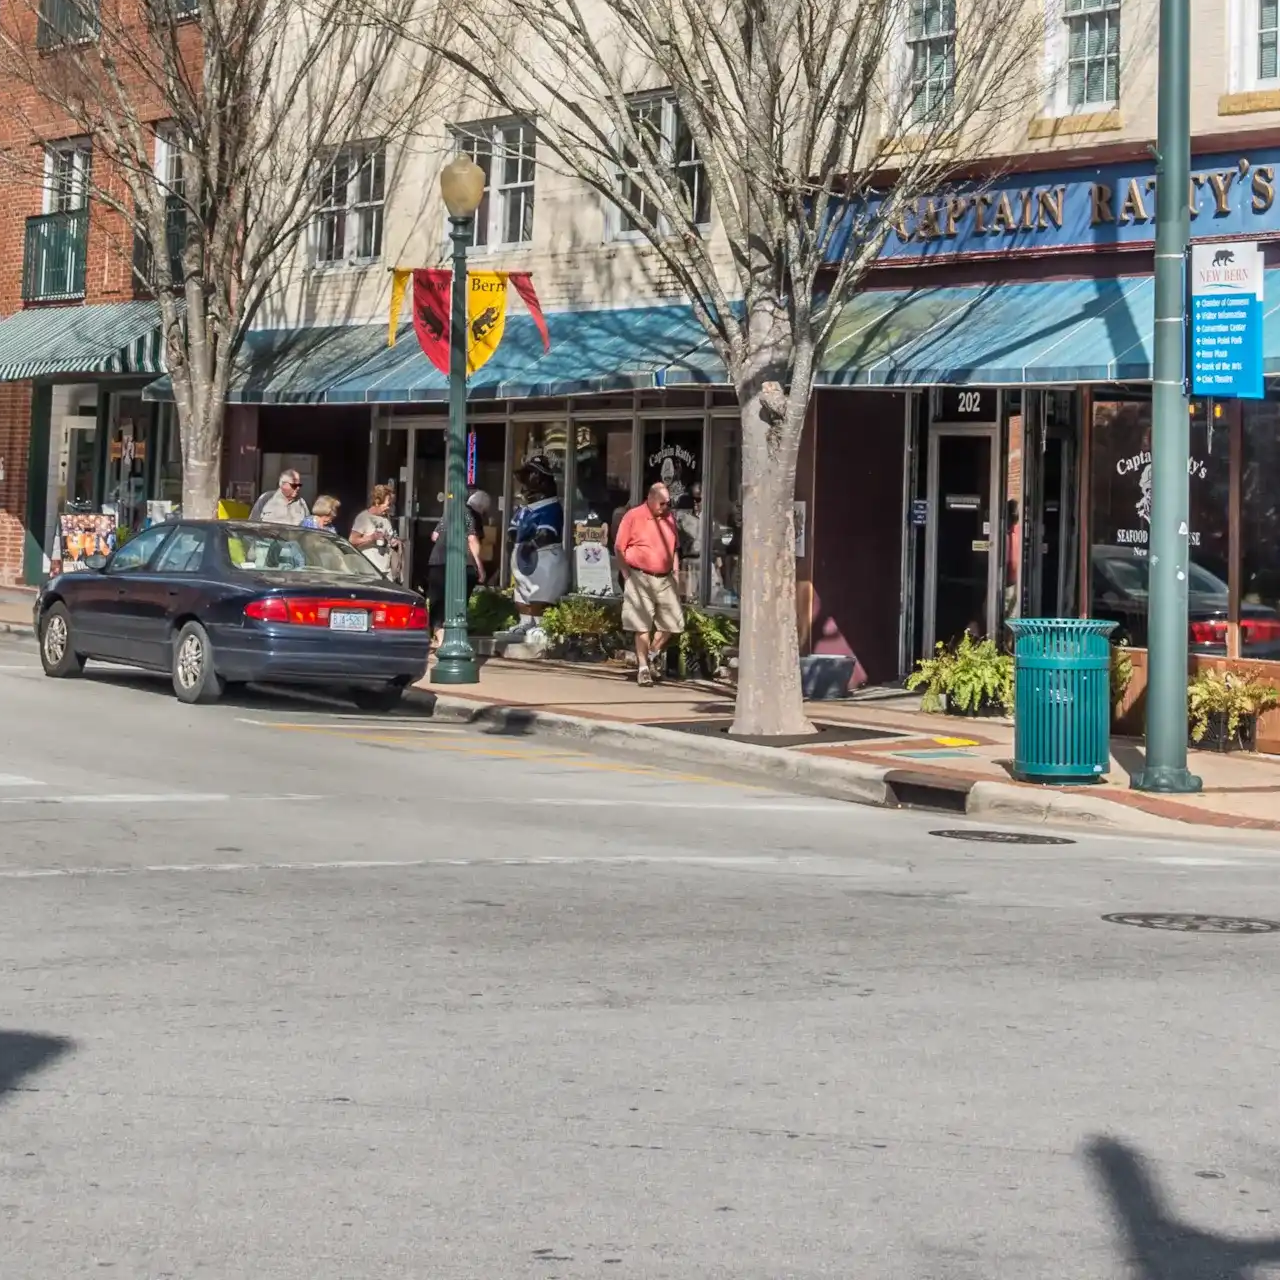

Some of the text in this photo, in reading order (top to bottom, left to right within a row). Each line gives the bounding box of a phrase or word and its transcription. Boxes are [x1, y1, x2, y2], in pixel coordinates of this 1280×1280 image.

[891, 158, 1275, 244] CAPTAIN RATY'S
[1200, 268, 1248, 282] NEW BERN
[472, 278, 506, 292] Bern
[1201, 310, 1246, 320] Visitor Information
[1202, 324, 1246, 333] Convention Center
[1202, 336, 1242, 345] Union Point Park
[1222, 362, 1230, 370] the
[1231, 362, 1242, 370] Arts
[1202, 375, 1213, 384] Civic
[958, 392, 981, 412] 202
[649, 444, 696, 470] Captain Ratty's
[1116, 450, 1151, 475] Capta
[1117, 529, 1149, 543] SEAFOOD
[1133, 546, 1148, 556] New
